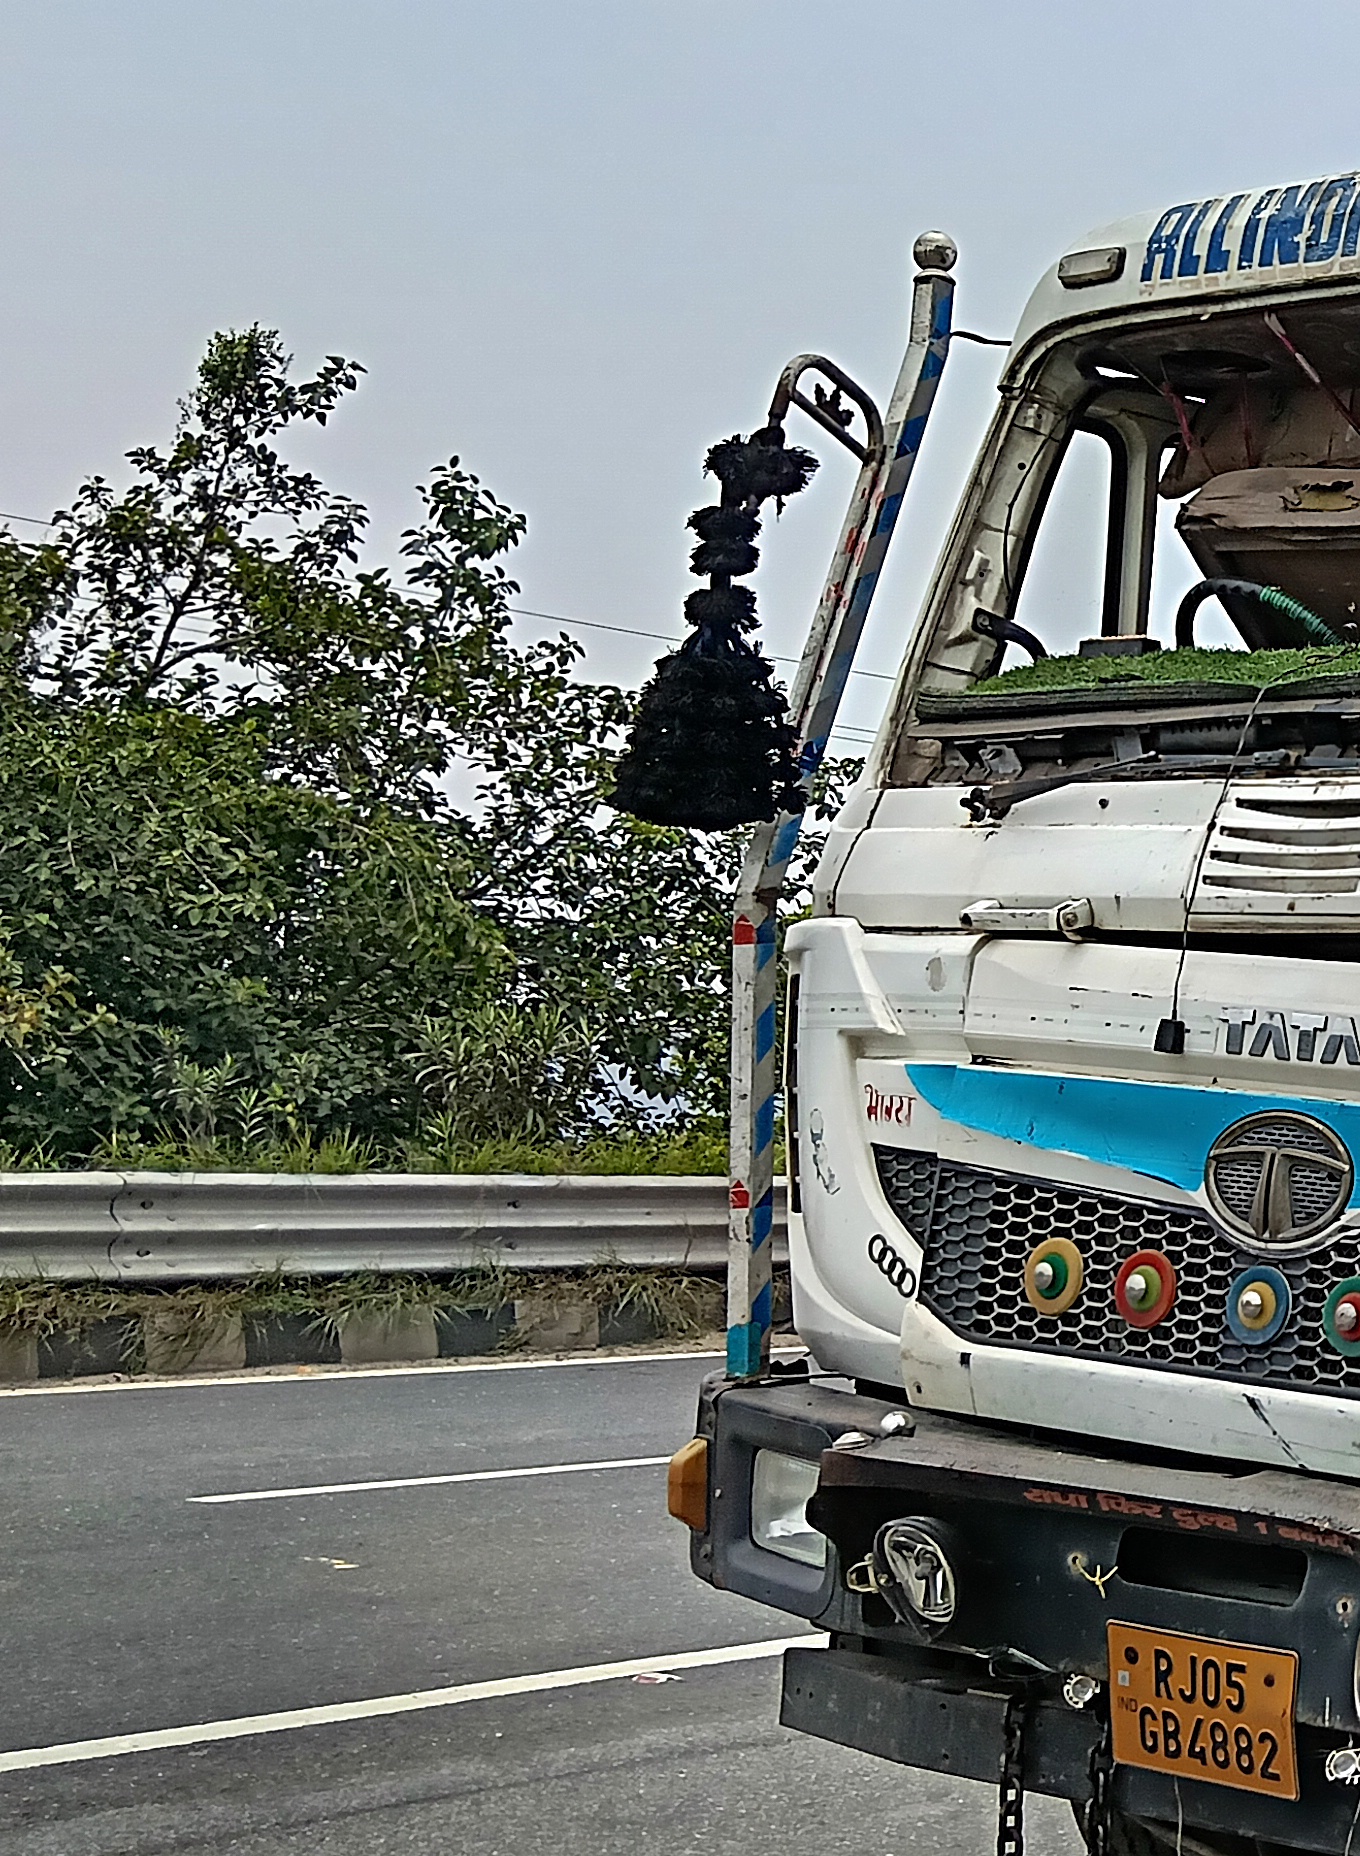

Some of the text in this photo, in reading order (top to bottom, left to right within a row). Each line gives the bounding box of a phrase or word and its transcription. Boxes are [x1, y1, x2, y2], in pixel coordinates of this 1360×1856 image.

[1117, 1696, 1139, 1713] IND
[1153, 1646, 1248, 1713] RJ05
[1138, 1704, 1282, 1782] GB4882
